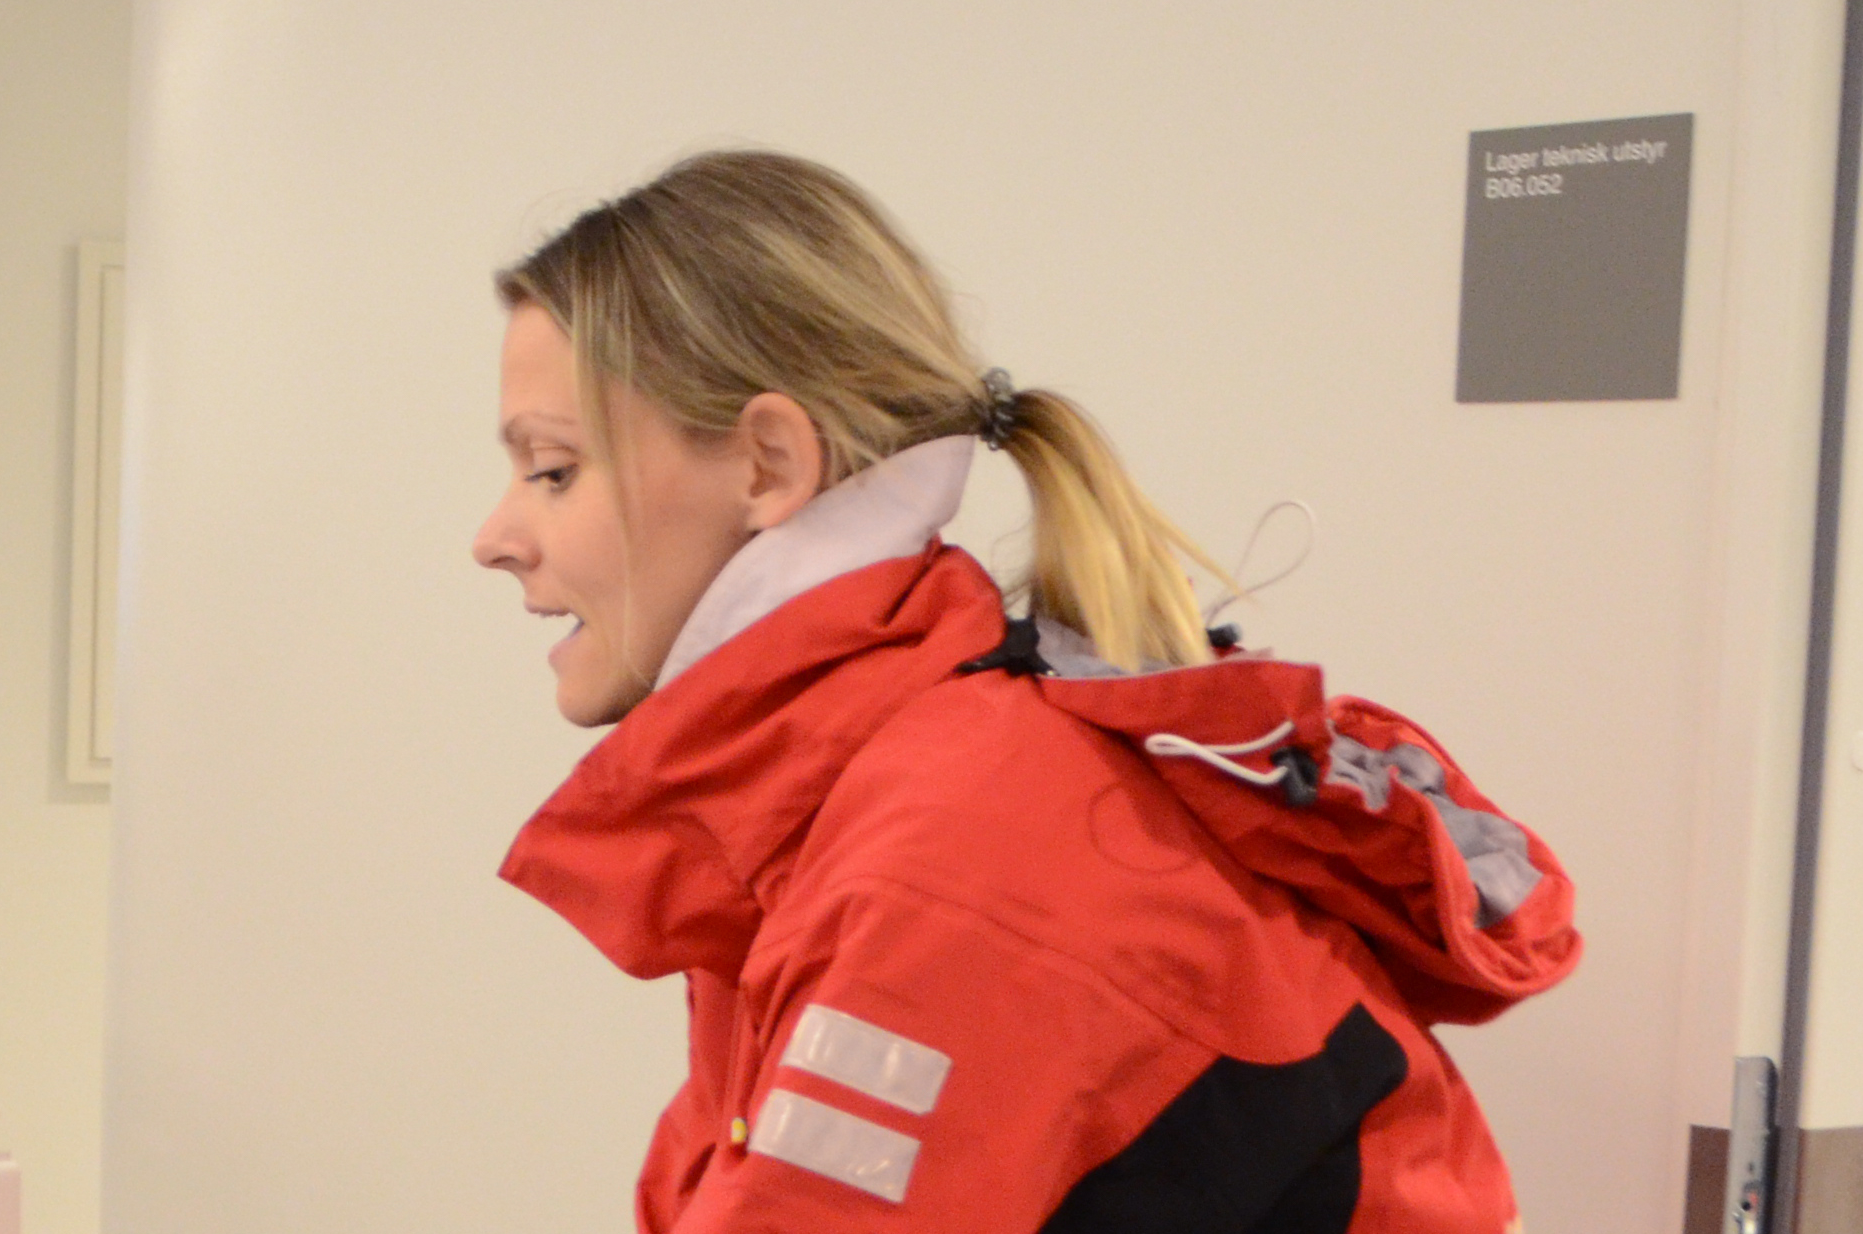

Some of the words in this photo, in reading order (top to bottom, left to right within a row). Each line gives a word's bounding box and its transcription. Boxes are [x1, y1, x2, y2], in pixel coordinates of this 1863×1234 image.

[1485, 150, 1538, 175] Lager
[1543, 143, 1608, 167] teknisk
[1613, 138, 1668, 164] utstyr
